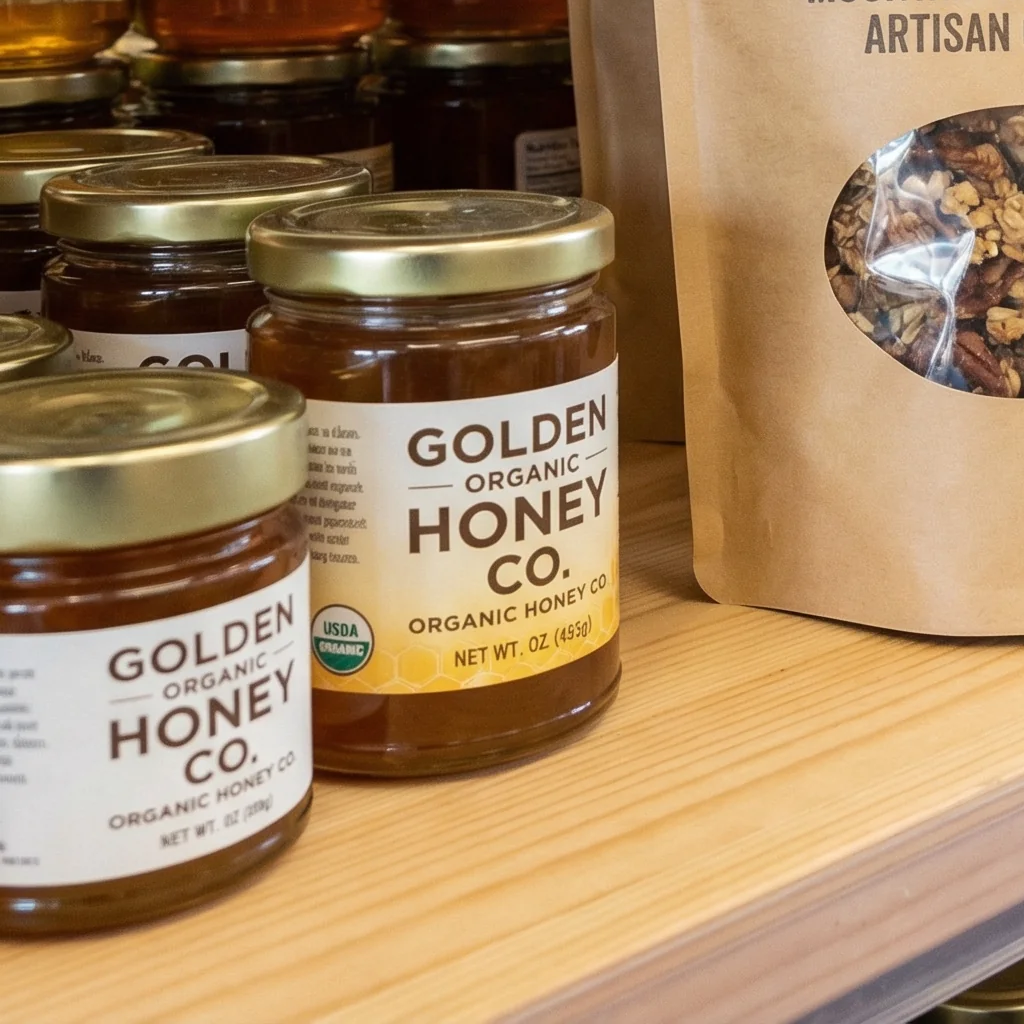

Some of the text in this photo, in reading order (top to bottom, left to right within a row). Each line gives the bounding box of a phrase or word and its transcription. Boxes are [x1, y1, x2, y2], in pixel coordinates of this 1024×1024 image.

[864, 13, 1010, 55] ARTISAN
[407, 394, 606, 467] GOLDEN
[465, 453, 579, 493] ORGANIC
[408, 467, 608, 554] HONEY
[487, 546, 570, 595] CO.
[323, 620, 359, 638] USDA
[408, 606, 518, 635] ORGANIC
[524, 583, 587, 620] HONEY
[108, 593, 294, 682] GOLDEN
[454, 647, 488, 668] NET
[493, 640, 524, 661] WT.
[529, 632, 550, 653] OZ
[162, 652, 268, 701] ORGANIC
[109, 658, 296, 760] HONEY
[184, 737, 258, 785] CO.
[108, 793, 210, 830] ORGANIC
[216, 766, 274, 805] HONEY
[160, 829, 190, 849] NET
